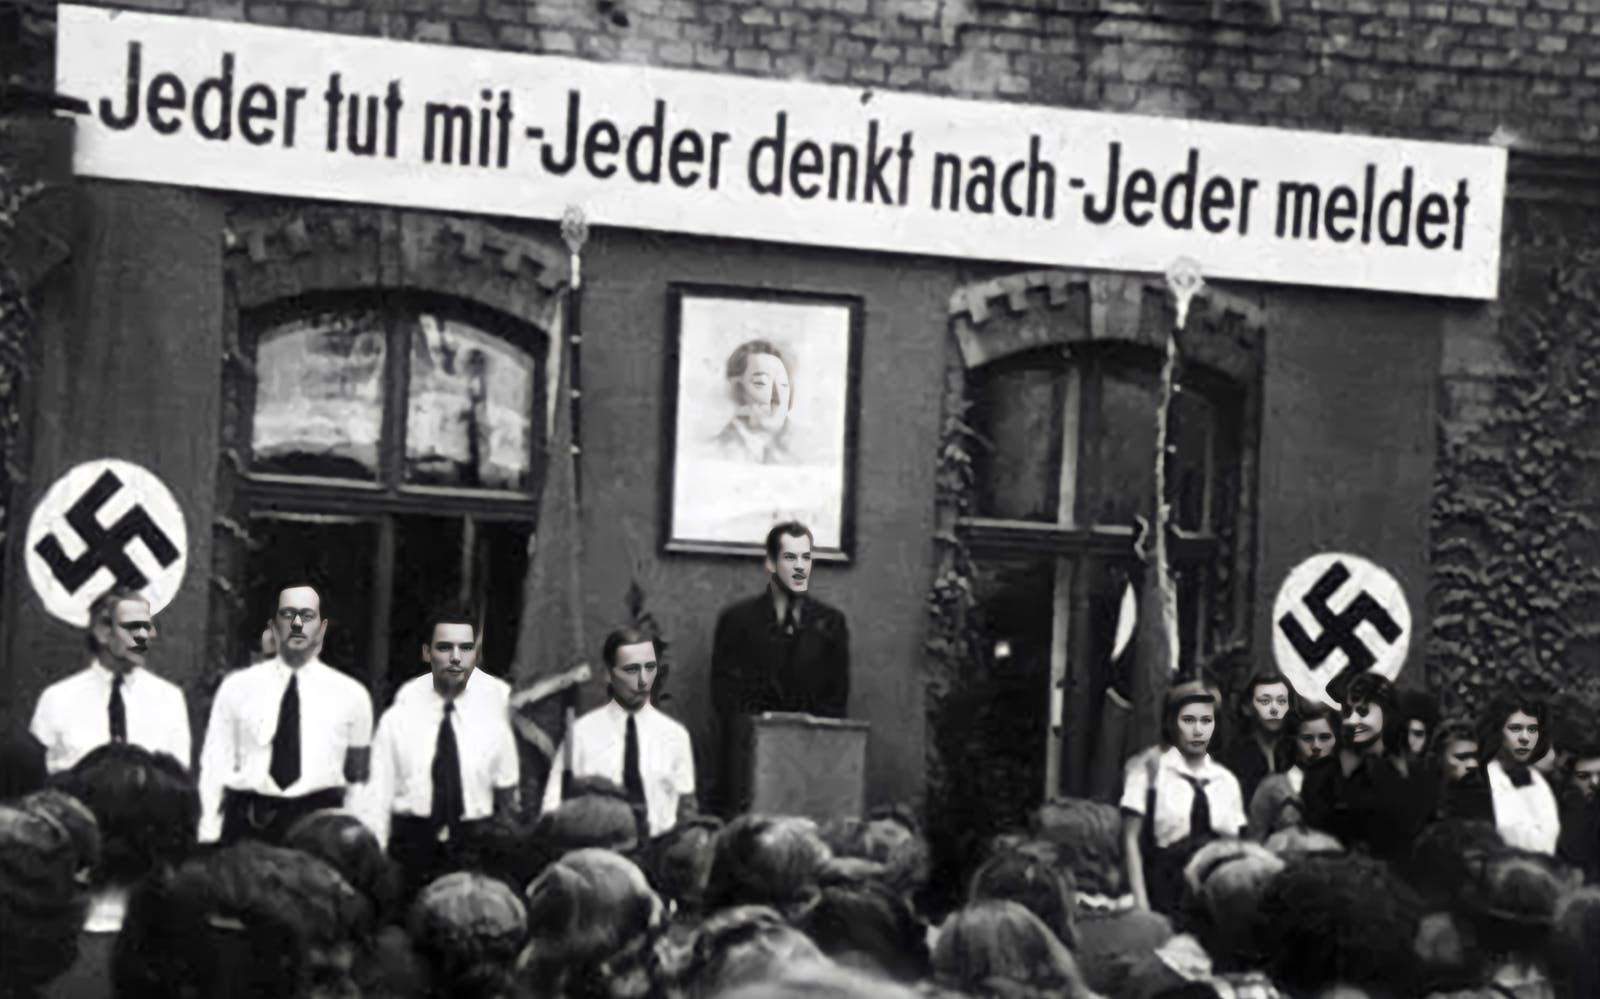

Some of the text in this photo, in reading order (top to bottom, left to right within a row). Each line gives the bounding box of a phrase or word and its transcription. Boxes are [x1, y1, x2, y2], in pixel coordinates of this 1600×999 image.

[99, 41, 307, 147] Jeder
[324, 73, 404, 158] tut
[423, 90, 513, 168] mit
[748, 112, 913, 205] denkt
[932, 135, 1055, 219] nach
[1275, 164, 1470, 250] meldet
